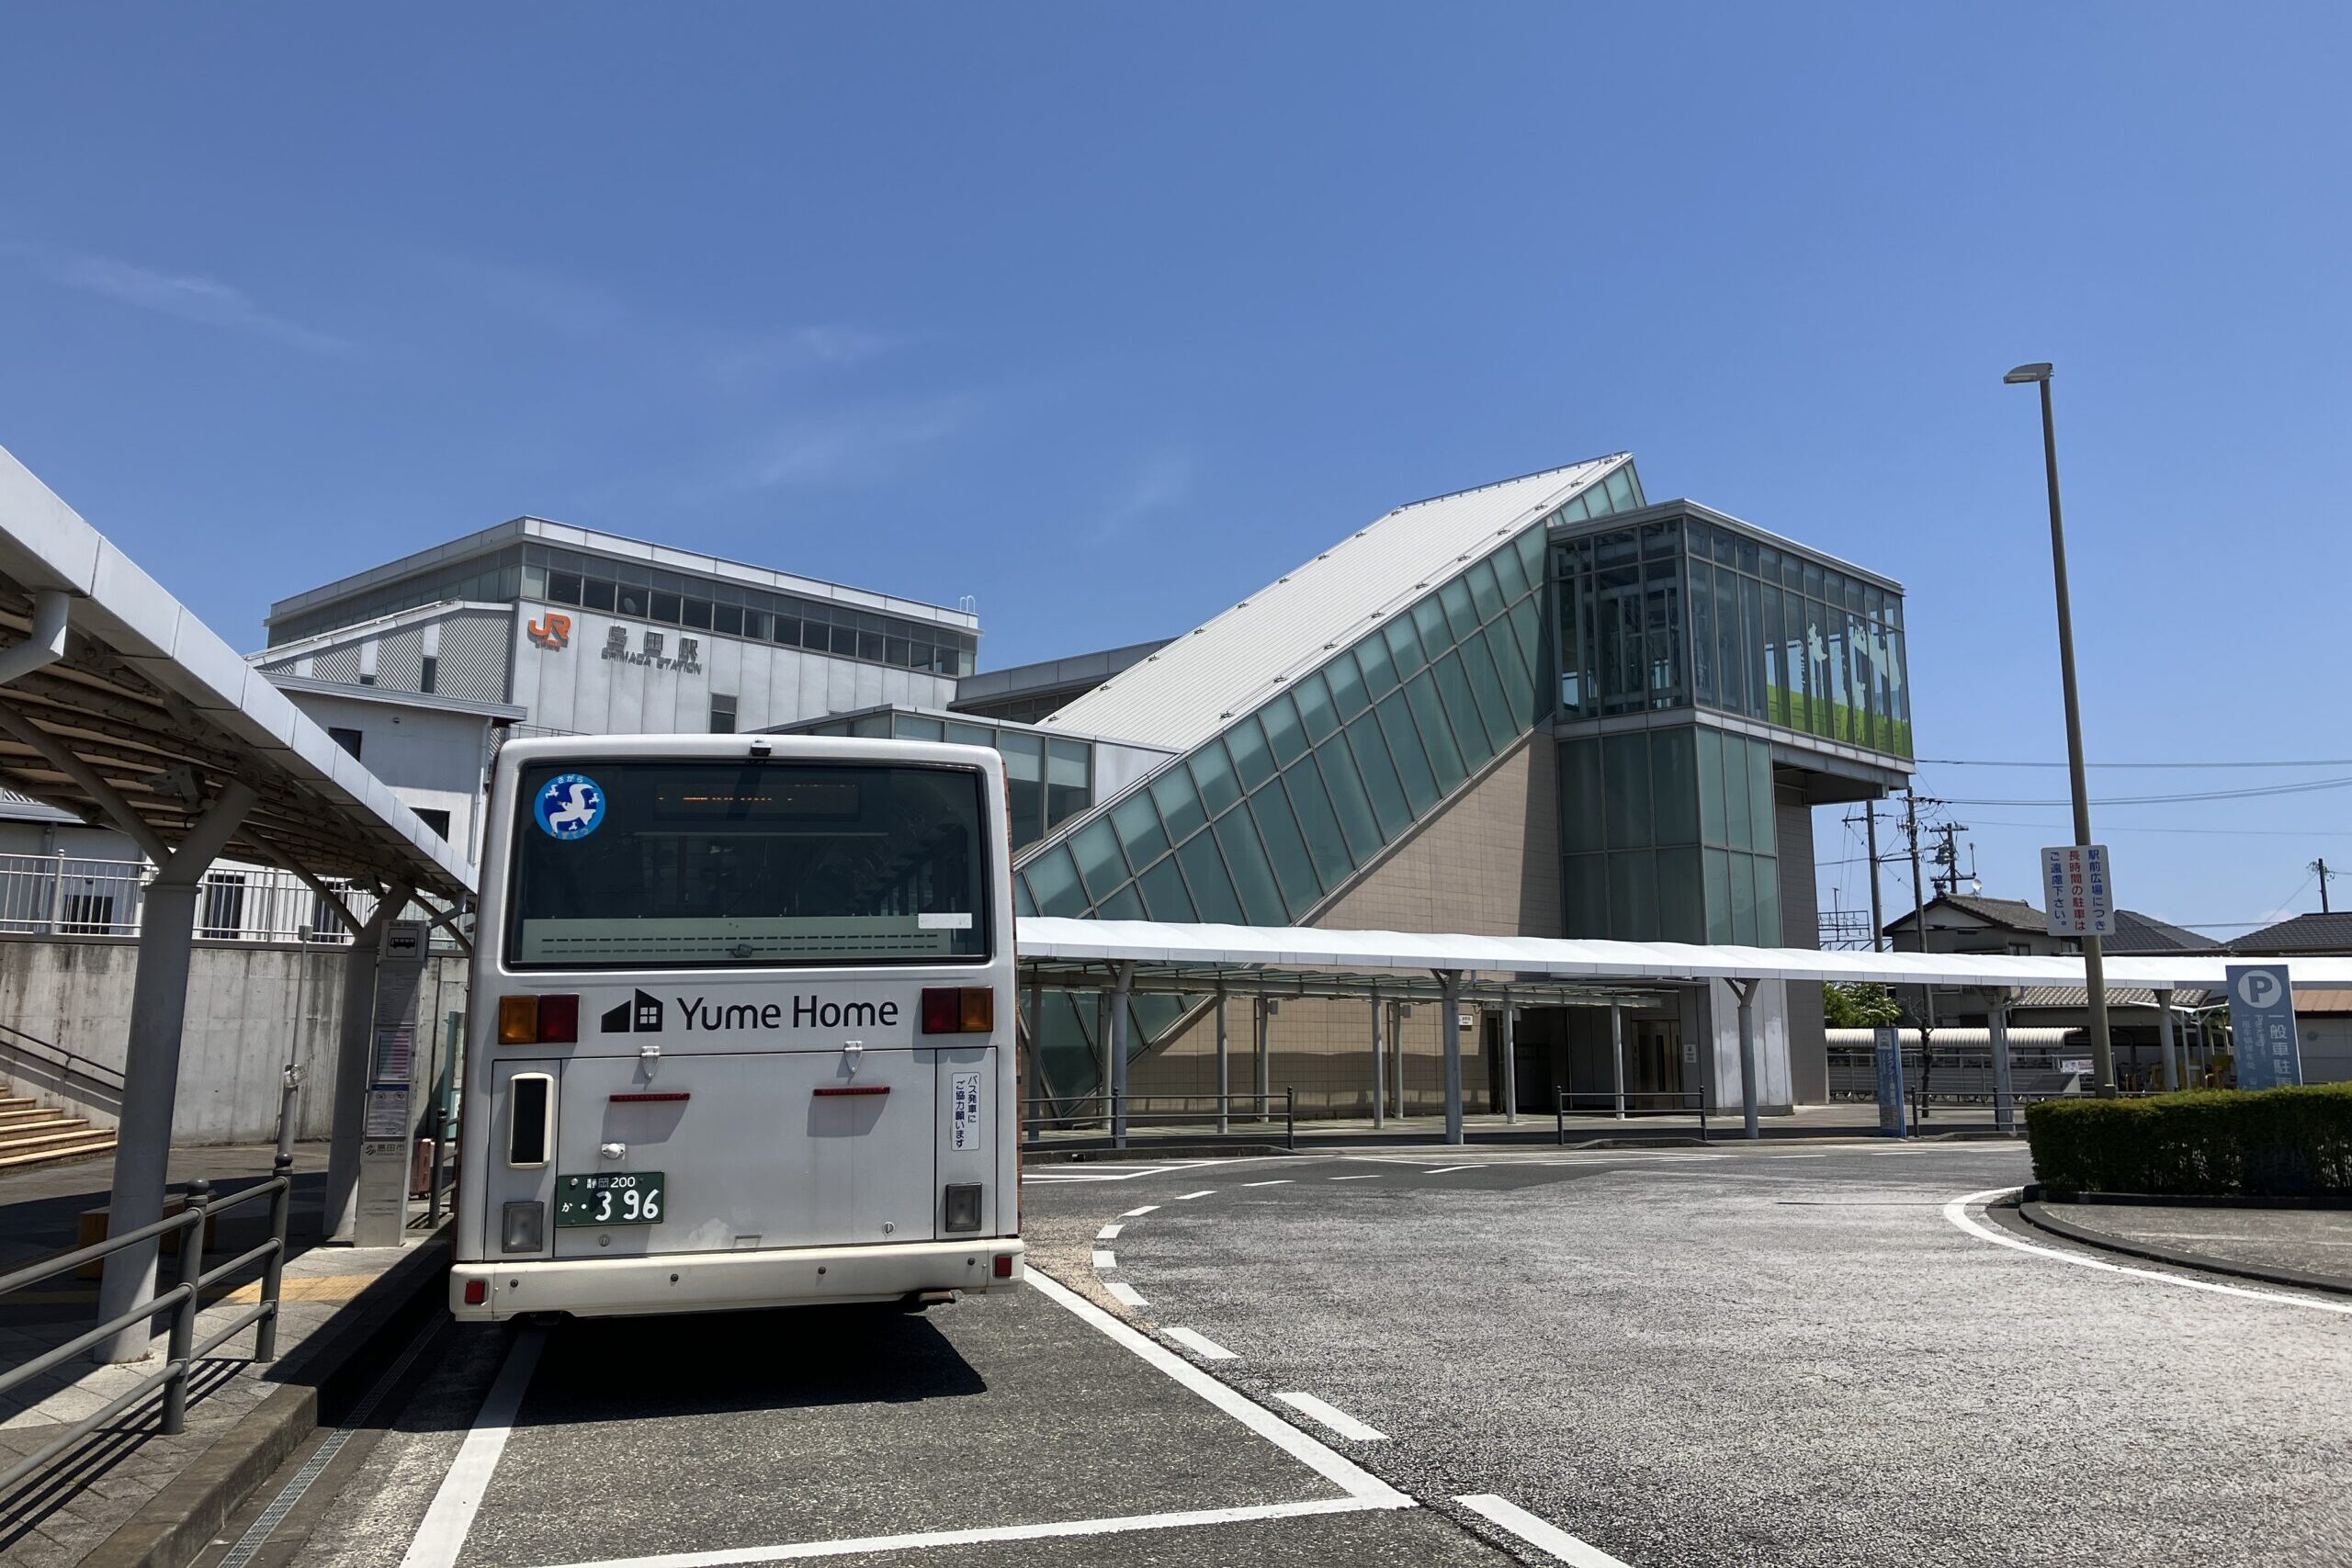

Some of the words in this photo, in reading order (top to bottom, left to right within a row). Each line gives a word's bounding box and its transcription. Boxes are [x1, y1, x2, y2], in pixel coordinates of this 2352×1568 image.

[528, 613, 571, 640] JR
[607, 626, 698, 660] 島田駅
[602, 647, 651, 667] SHIMADA
[656, 657, 702, 675] STATION
[557, 775, 583, 784] さがら
[2051, 852, 2067, 926] ご遠慮下さい。
[2069, 851, 2086, 931] 長時間の駐車は
[2088, 850, 2106, 931] 駅前広場につき
[2248, 976, 2272, 1002] P
[677, 997, 781, 1031] Yume
[793, 995, 899, 1028] Home
[956, 1079, 966, 1148] ご協力願います
[967, 1075, 978, 1123] バス発車に
